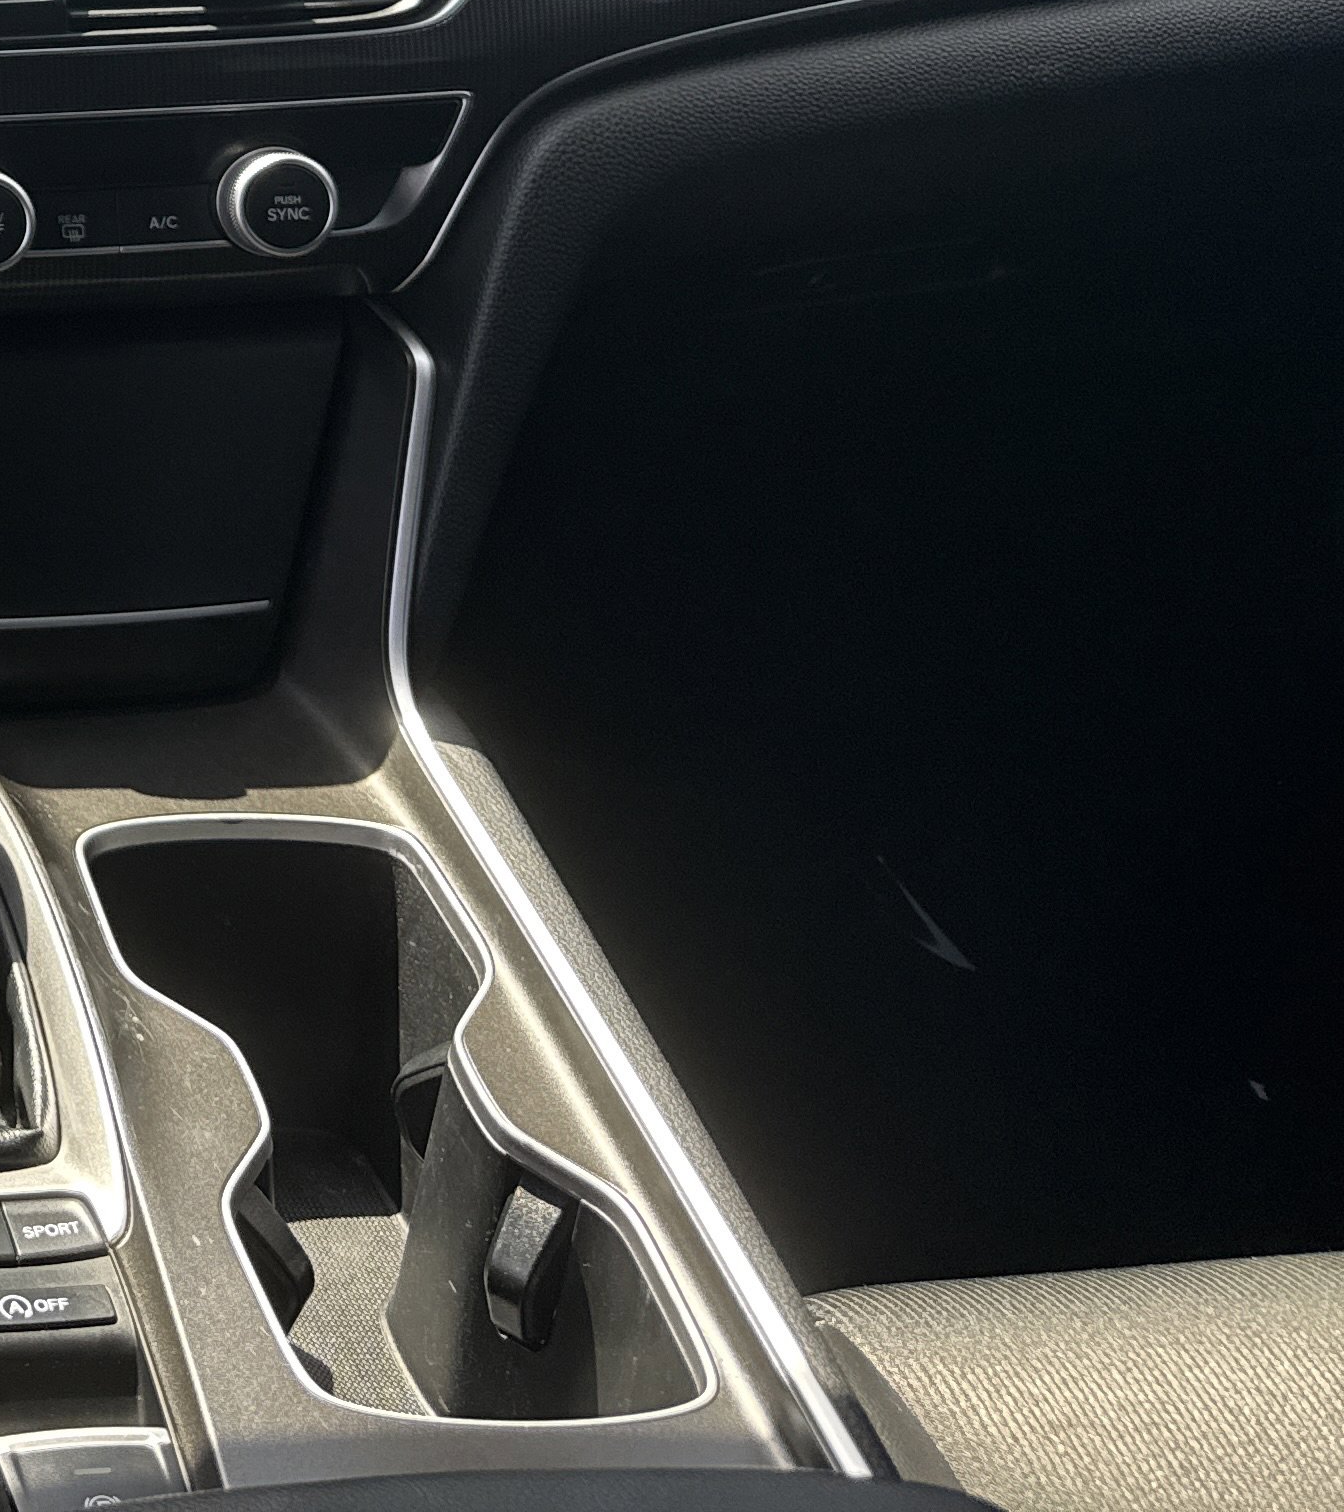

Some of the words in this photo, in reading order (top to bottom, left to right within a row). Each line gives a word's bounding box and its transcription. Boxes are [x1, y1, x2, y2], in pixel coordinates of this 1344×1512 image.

[273, 196, 301, 205] PUSH
[57, 214, 86, 225] REAR
[267, 207, 310, 222] SYNC
[149, 216, 178, 231] A/C
[21, 1220, 80, 1239] SPORT
[33, 1297, 70, 1313] OFF
